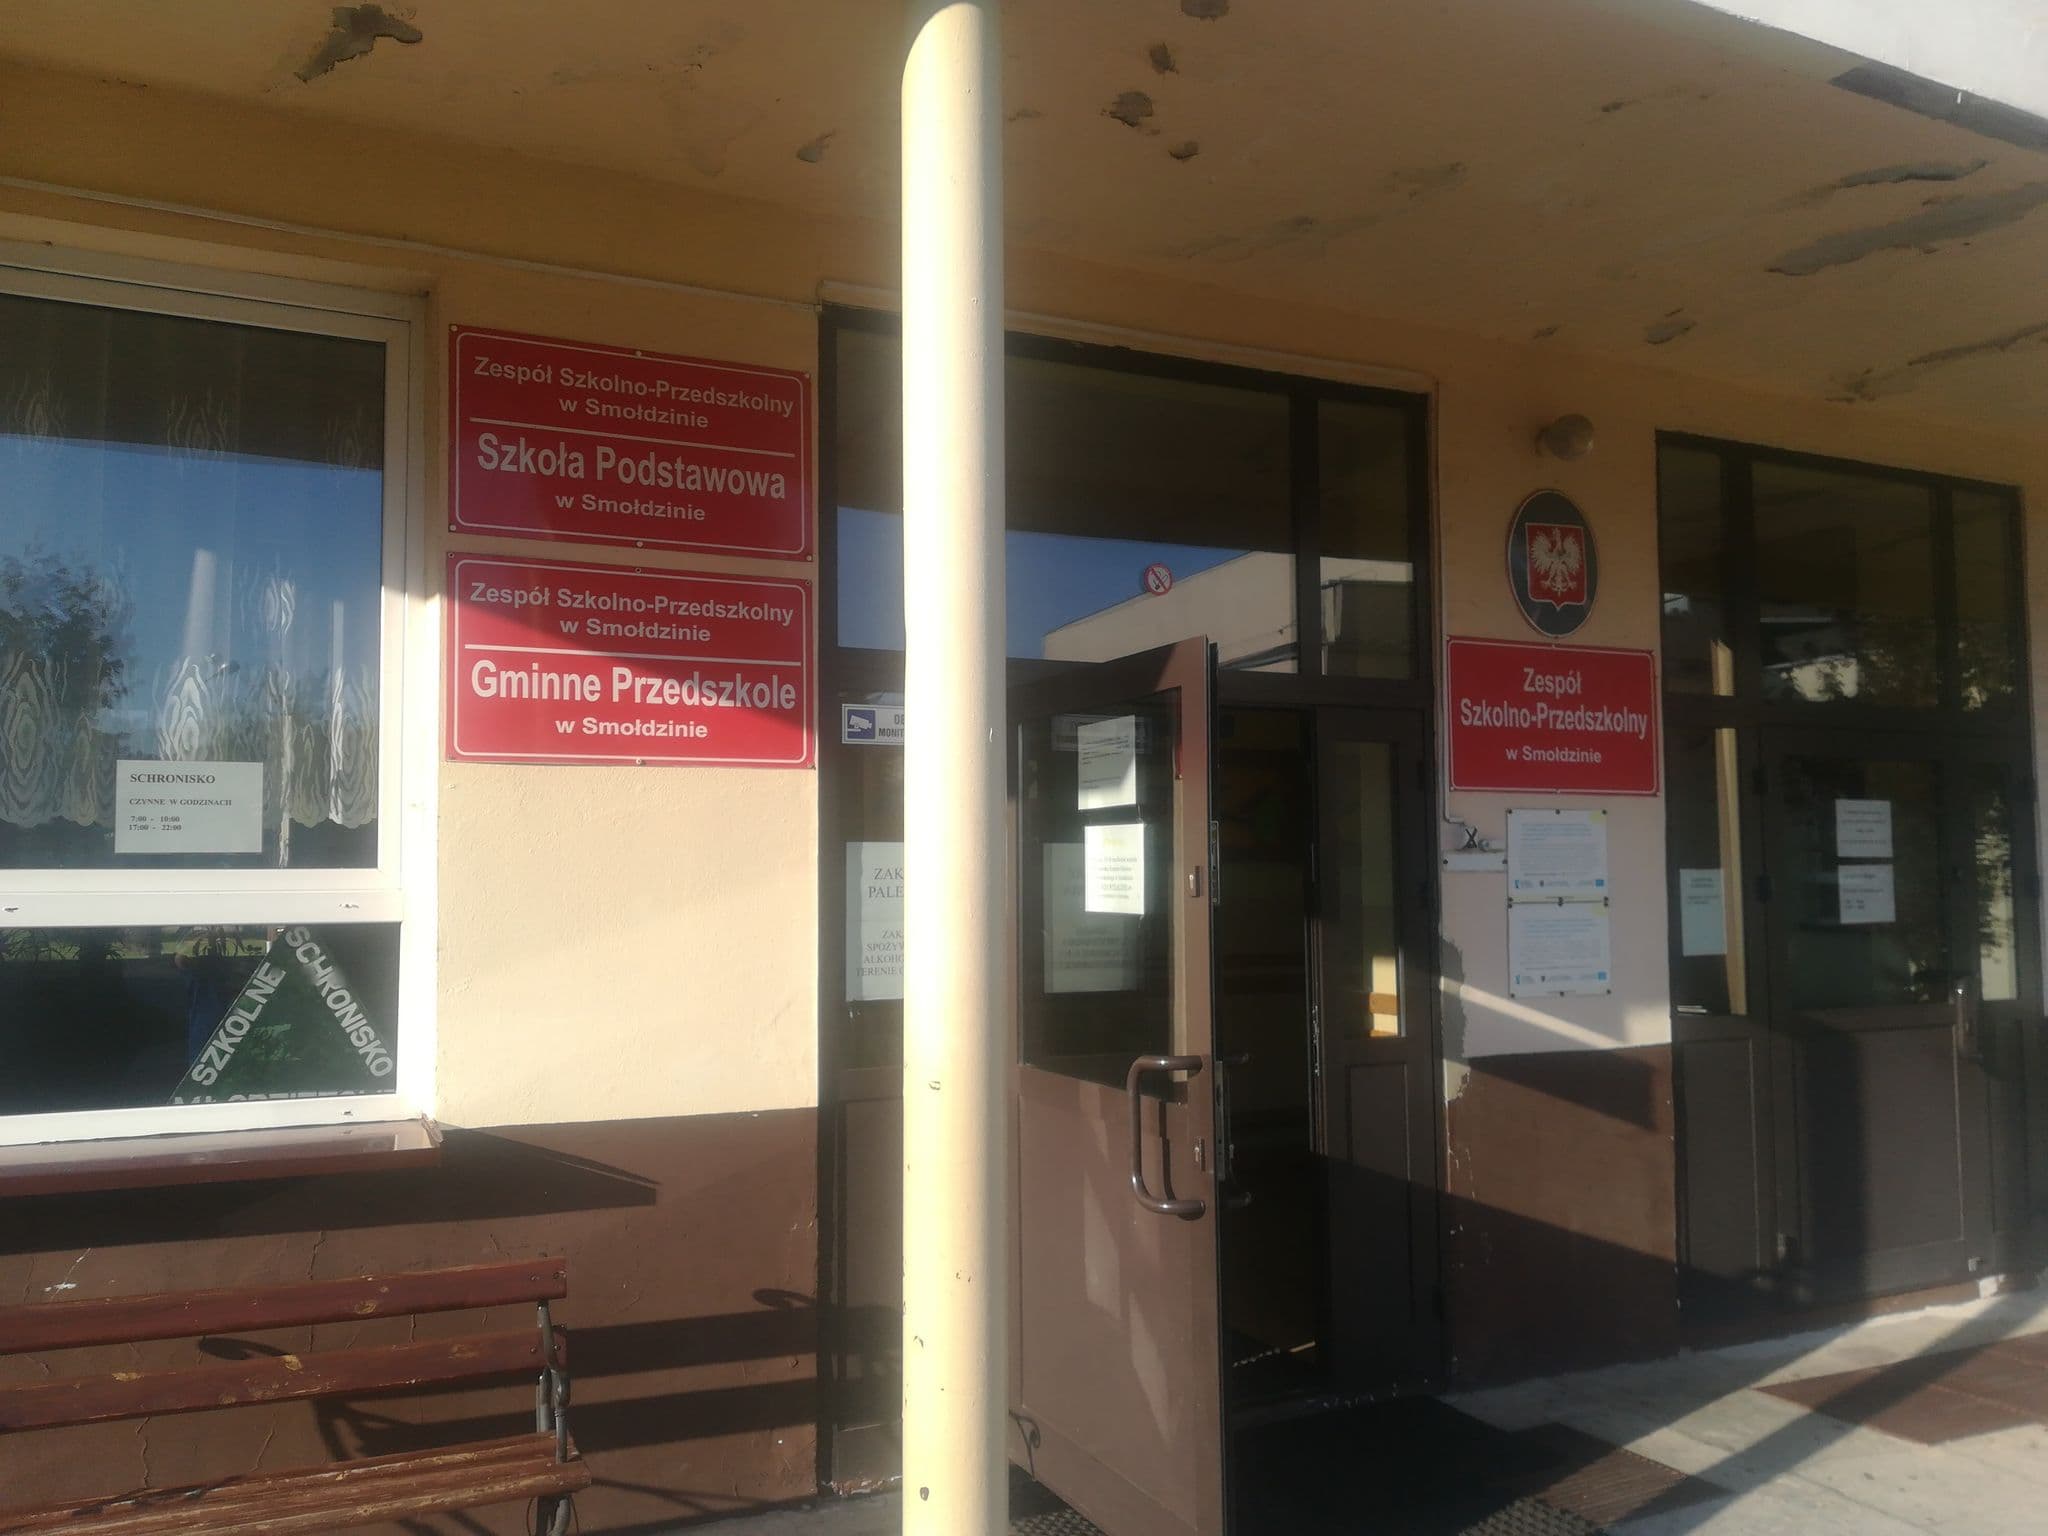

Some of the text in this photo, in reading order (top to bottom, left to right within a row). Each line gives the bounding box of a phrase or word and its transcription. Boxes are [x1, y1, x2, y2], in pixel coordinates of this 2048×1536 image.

[474, 355, 794, 418] Zespół Szkolno-Przedszkolny
[559, 398, 710, 429] w Smołdzinie
[477, 432, 786, 500] Szkoła Podstawowa
[555, 493, 706, 522] w Smołdzinie
[470, 582, 794, 627] Zespół Szkolno-Przedszkolny
[560, 617, 711, 642] w Smołdzinie
[471, 659, 796, 711] Gminne Przedszkole
[1523, 667, 1582, 699] Zespół
[555, 717, 709, 739] w Smołdzinie
[1460, 698, 1647, 740] Szkolno-Przedszkolny
[1505, 745, 1602, 764] w Smołdzinie
[129, 773, 216, 784] SCHRONISKO
[128, 798, 166, 806] CZYNNE
[169, 798, 179, 806] W
[191, 962, 287, 1086] SZKOLNE
